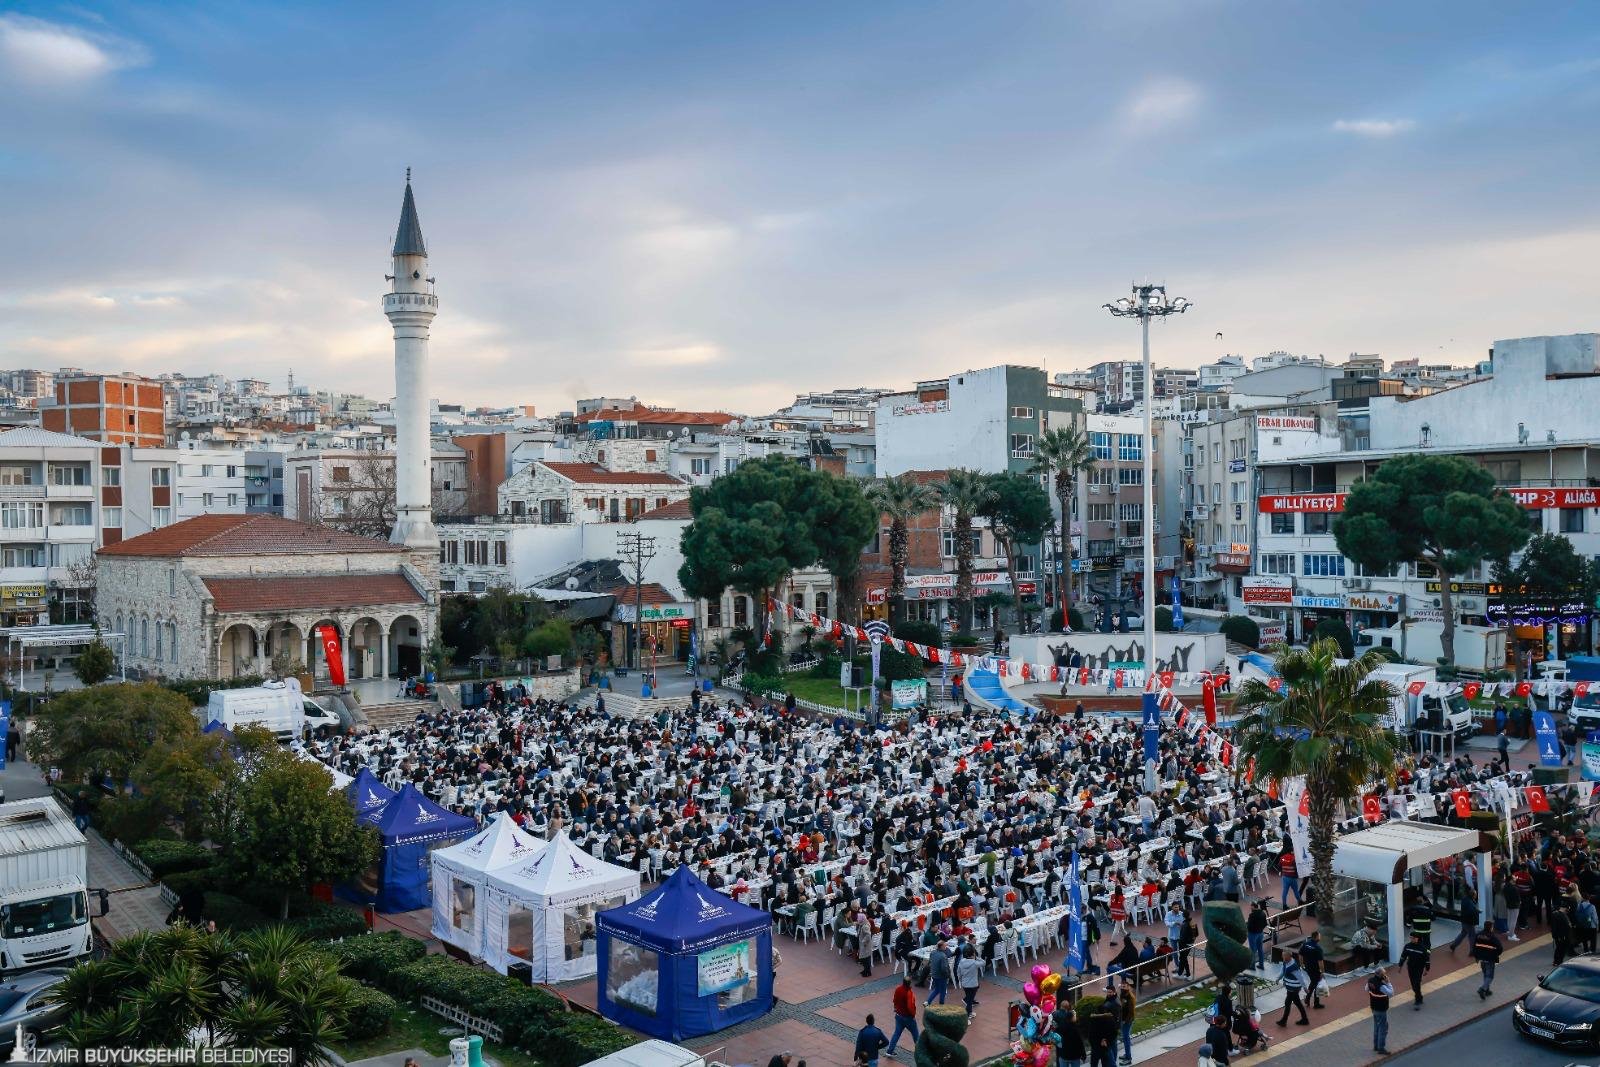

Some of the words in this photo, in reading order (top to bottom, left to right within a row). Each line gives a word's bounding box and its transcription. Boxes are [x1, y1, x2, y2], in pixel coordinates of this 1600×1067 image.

[1258, 417, 1281, 428] FERAH
[1564, 490, 1596, 504] ALİAĞA
[1273, 495, 1337, 511] MİLLİYETÇİ
[975, 573, 998, 584] JUMP
[1428, 583, 1459, 592] LUO
[1301, 596, 1339, 608] HAYTEKS
